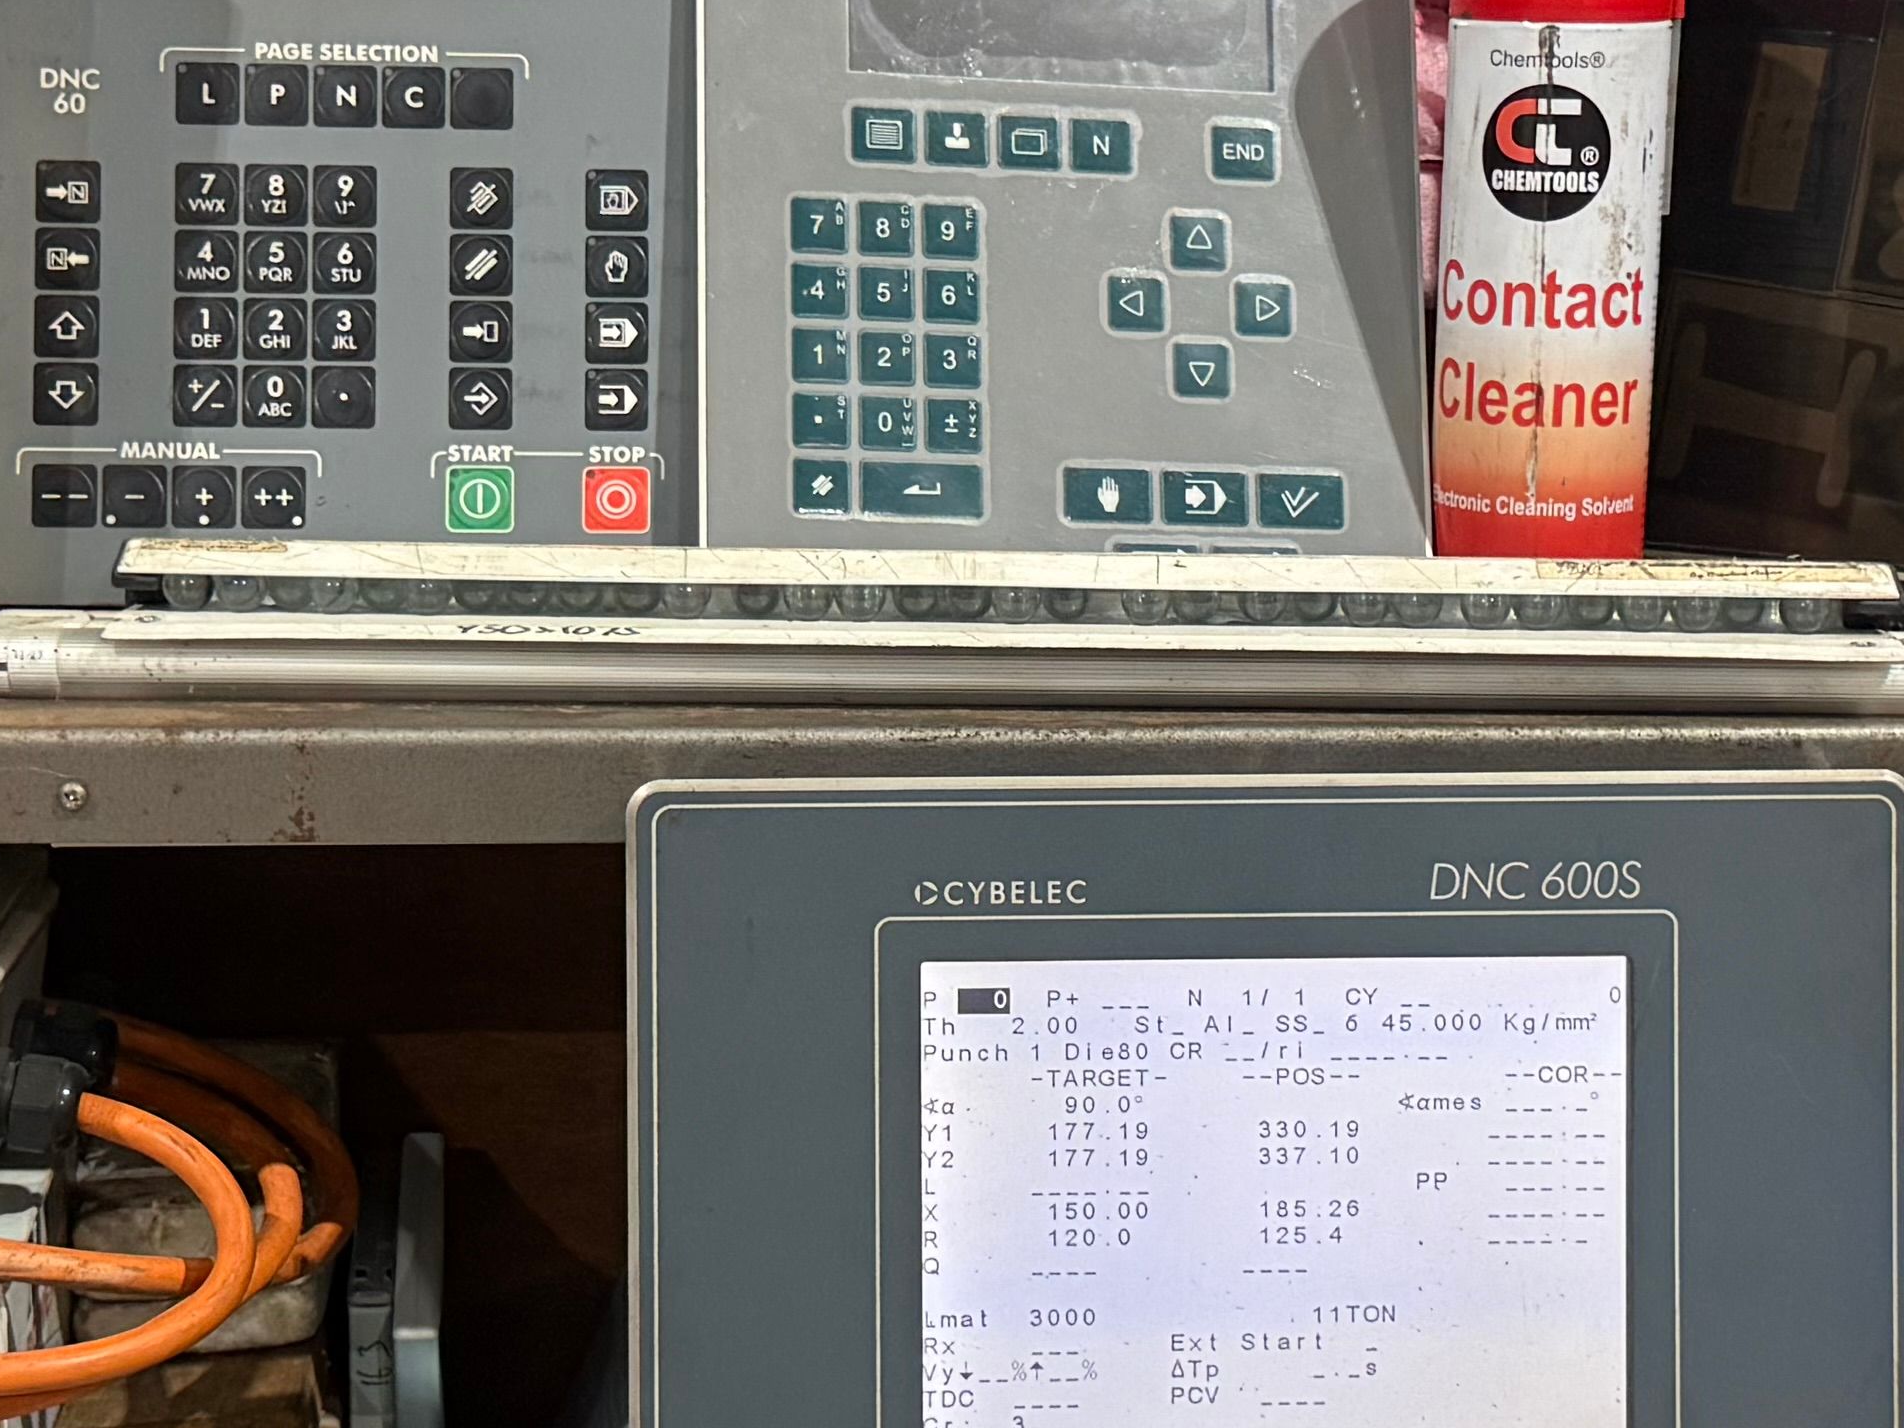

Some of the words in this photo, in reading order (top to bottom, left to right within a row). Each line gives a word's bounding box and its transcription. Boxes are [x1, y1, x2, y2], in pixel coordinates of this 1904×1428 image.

[254, 43, 312, 60] PAGE
[319, 44, 438, 64] SELECTION
[40, 69, 100, 90] DNC
[53, 93, 85, 114] 60
[1222, 142, 1264, 162] END
[1492, 169, 1599, 193] CHEMTOOLS
[1443, 259, 1644, 329] Contact
[1439, 356, 1638, 428] Cleaner
[120, 442, 220, 460] MANUAL
[447, 445, 513, 464] START
[589, 446, 645, 465] STOP
[1496, 494, 1576, 521] Cleaning
[1582, 494, 1634, 516] Solvent
[1430, 862, 1529, 900] DNC
[1541, 860, 1642, 900] 600S
[944, 880, 1088, 906] CYBELEC
[1345, 987, 1377, 1006] CY
[923, 1017, 955, 1035] Th
[1011, 1016, 1078, 1036] 2.00
[1381, 1013, 1483, 1032] 45.000
[923, 1043, 1009, 1064] Punch
[1065, 1042, 1149, 1061] Die80
[1170, 1042, 1203, 1060] CR
[923, 1124, 953, 1143] Y1
[1048, 1122, 1149, 1142] 177.19
[1260, 1121, 1360, 1140] 330.19
[923, 1151, 954, 1170] Y2
[1048, 1150, 1149, 1169] 177.19
[1260, 1148, 1360, 1167] 337.10
[1417, 1172, 1448, 1191] PP
[1048, 1203, 1149, 1222] 150.00
[1261, 1201, 1360, 1220] 185.26
[1048, 1229, 1131, 1248] 120.0
[1261, 1227, 1343, 1246] 125.4
[1030, 1310, 1096, 1327] 3000
[1313, 1305, 1396, 1324] 11TON
[1170, 1334, 1218, 1353] Ext
[1241, 1334, 1323, 1353] Start
[924, 1391, 974, 1409] TDC
[1170, 1387, 1219, 1406] PCV
